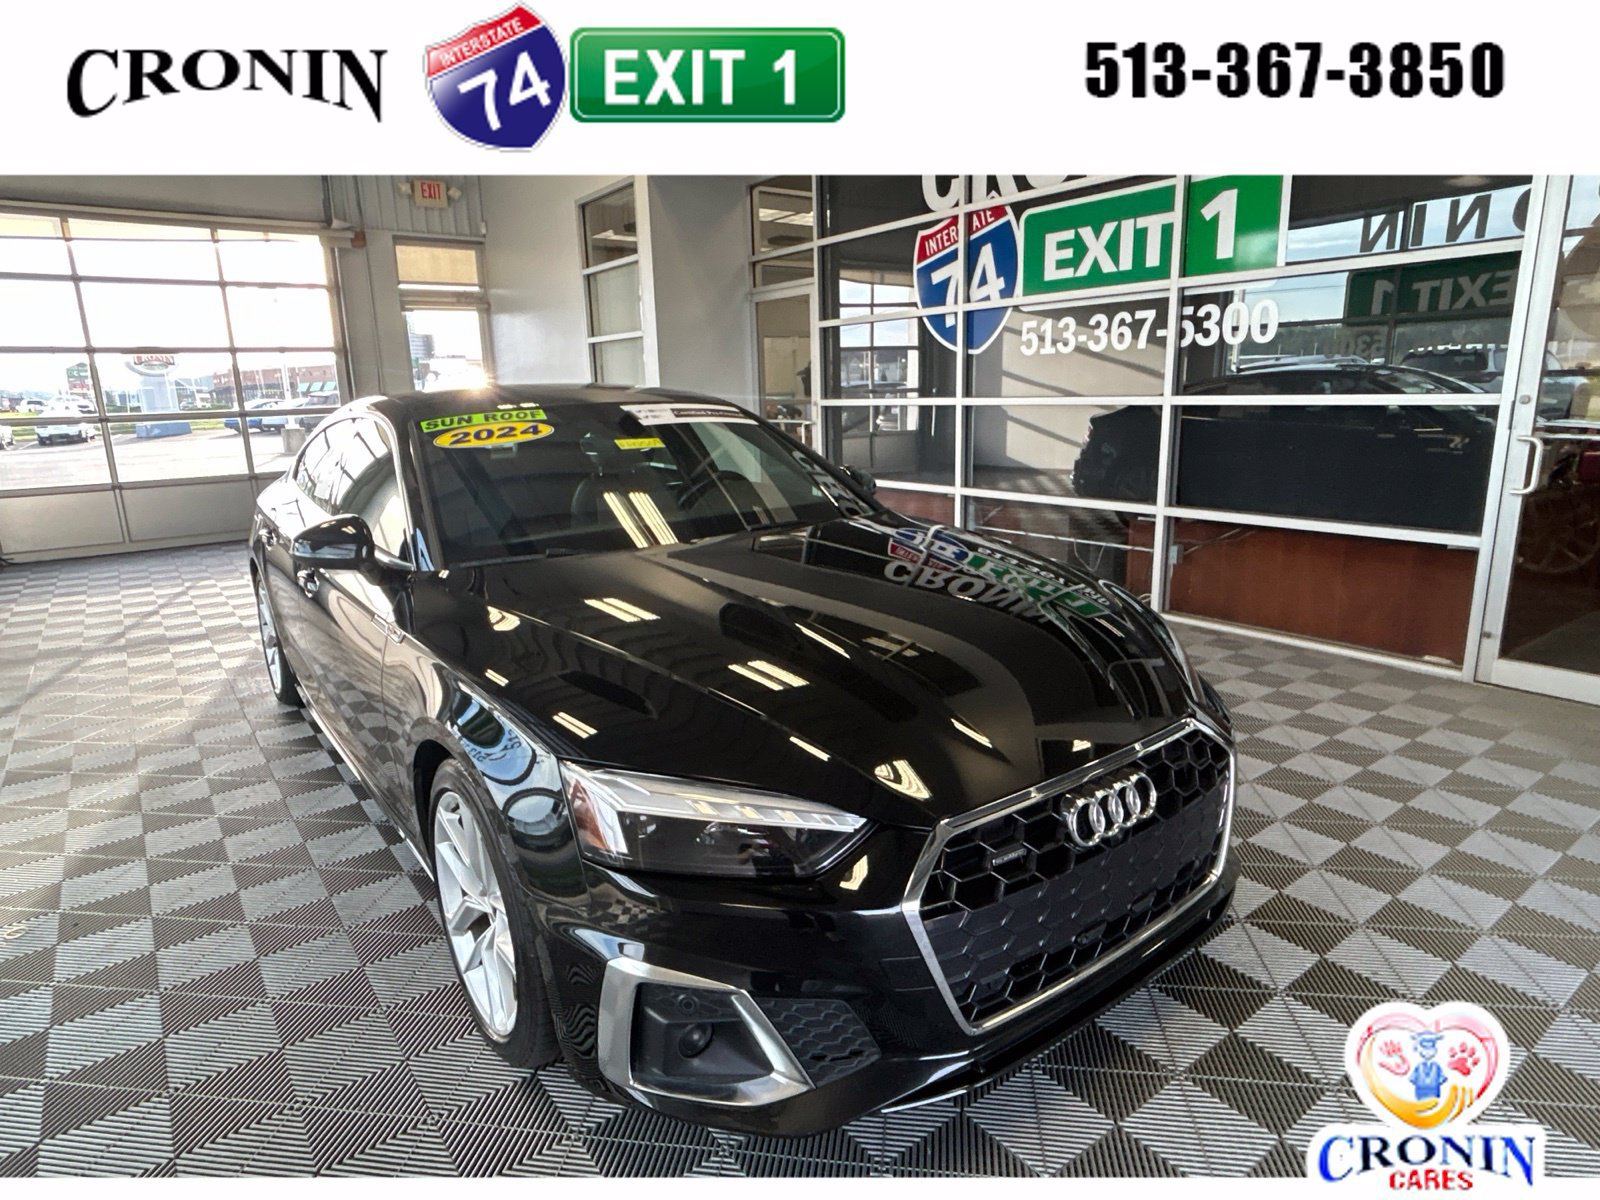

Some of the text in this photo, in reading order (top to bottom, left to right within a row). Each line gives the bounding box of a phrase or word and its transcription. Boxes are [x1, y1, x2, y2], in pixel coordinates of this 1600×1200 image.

[419, 181, 441, 200] EXIT
[925, 211, 995, 256] INTERATE
[1043, 189, 1238, 281] EXIT 1
[931, 243, 1005, 328] 74
[1020, 298, 1280, 356] 513-367-5300
[425, 411, 541, 430] SUN ROOF
[449, 425, 543, 446] 2024
